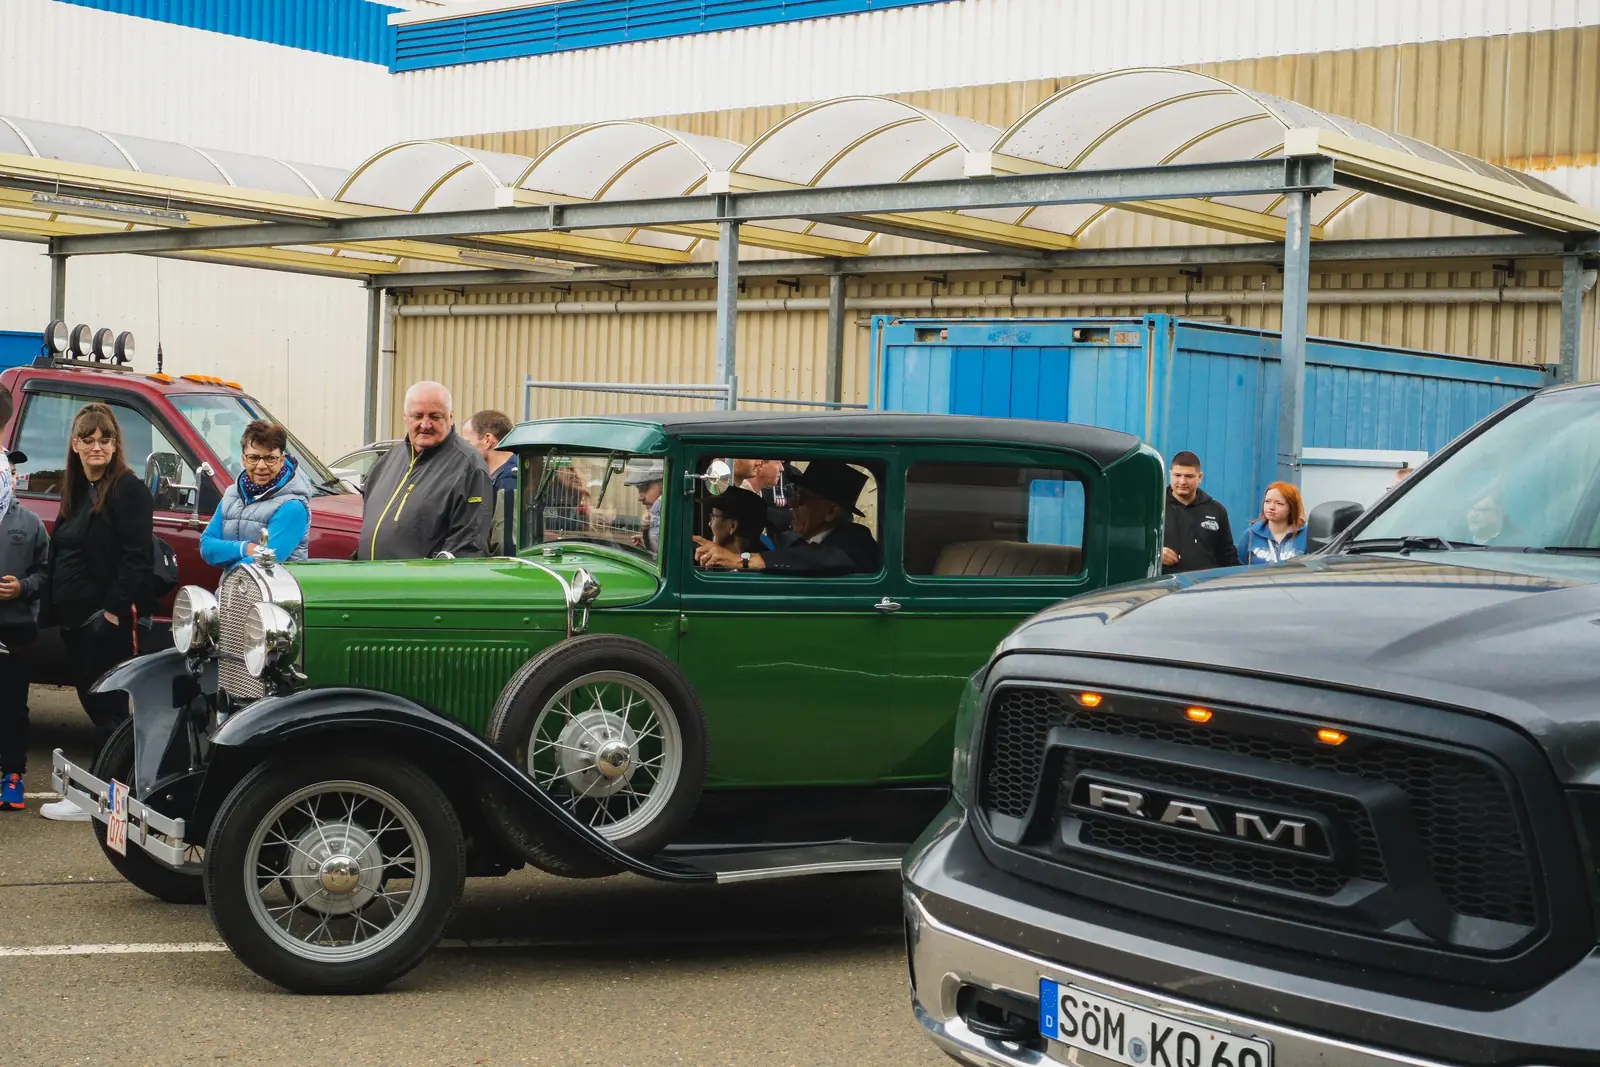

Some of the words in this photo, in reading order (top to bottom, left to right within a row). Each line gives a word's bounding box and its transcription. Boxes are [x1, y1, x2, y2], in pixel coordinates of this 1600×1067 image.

[1089, 784, 1306, 847] RAM
[1046, 1015, 1053, 1027] D
[1060, 995, 1125, 1055] SÖM
